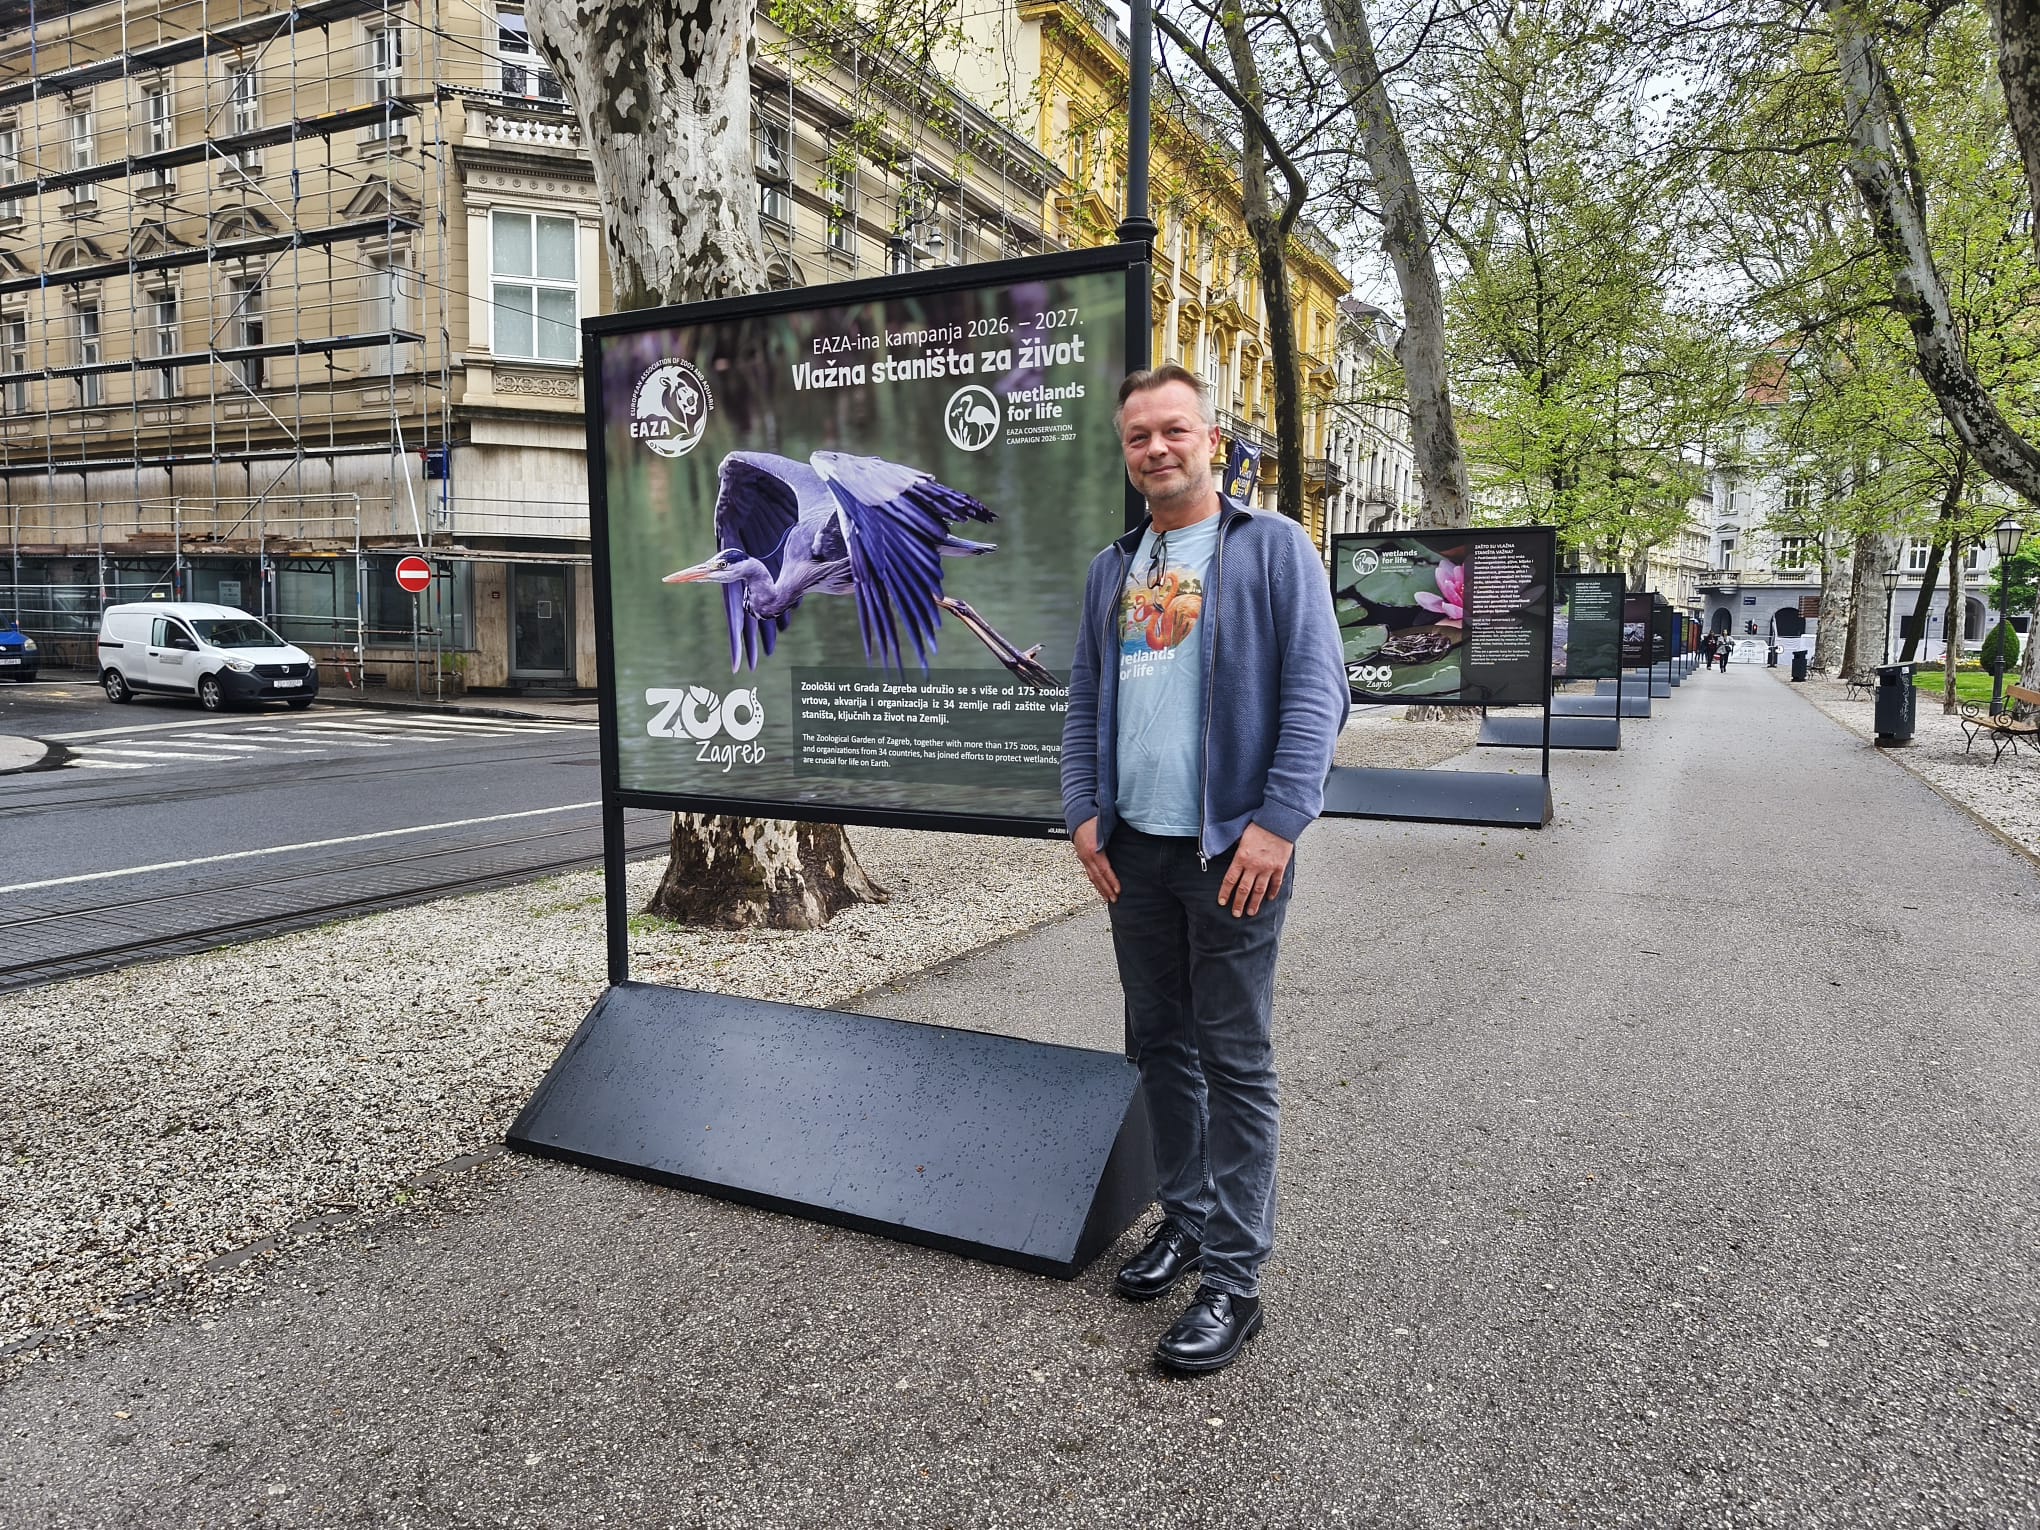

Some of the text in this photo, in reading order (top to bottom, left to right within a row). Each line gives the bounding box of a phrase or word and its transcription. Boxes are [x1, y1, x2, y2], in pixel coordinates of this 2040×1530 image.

[813, 333, 880, 355] EAZA-ina
[885, 323, 962, 347] kampanja
[967, 316, 1014, 338] 2026.
[1035, 308, 1084, 330] 2027.
[792, 334, 1085, 391] Vlažna staništa za život
[631, 381, 643, 416] EUROPEAN
[641, 357, 671, 381] ASSOCIATION
[680, 358, 695, 370] ZOOS
[694, 368, 704, 381] AND
[702, 381, 714, 411] AQUARIA
[1007, 382, 1085, 404] wetlands
[1007, 403, 1063, 422] for life
[630, 420, 671, 438] EAZA
[1006, 424, 1073, 436] EAZA CONSERVATION
[1006, 436, 1040, 445] CAMPAIGN
[1041, 434, 1057, 442] 2026
[1061, 433, 1077, 441] 2027
[1381, 549, 1418, 557] wetlands
[1395, 556, 1408, 564] life
[1119, 663, 1154, 680] or life
[1348, 664, 1393, 681] ZOO
[801, 681, 1070, 697] Zoološki vrt Grada Zagreba udružio se s više od 175 zoološ
[1366, 680, 1393, 691] Zagreb
[801, 696, 1069, 712] vrtova, akvarija i organizacija iz 34 zemlje radi zaštite vlaž
[645, 685, 765, 742] ZOO
[802, 710, 950, 725] staništa, ključnih za život na Zemlji.
[802, 733, 815, 741] The
[816, 734, 850, 743] Zoological
[851, 735, 876, 744] Garden
[877, 736, 885, 744] of
[886, 737, 912, 747] Zagreb,
[914, 738, 944, 747] together
[946, 739, 962, 748] with
[985, 740, 1002, 749] than
[1004, 741, 1018, 750] 175
[1020, 744, 1040, 752] zoos,
[695, 740, 766, 773] Zagreb
[802, 745, 1060, 765] and organizations from 34 countries, has joined efforts to protect wetlands,
[814, 756, 837, 765] crucial
[837, 757, 847, 765] for
[848, 757, 860, 766] life
[870, 759, 891, 768] Earth.
